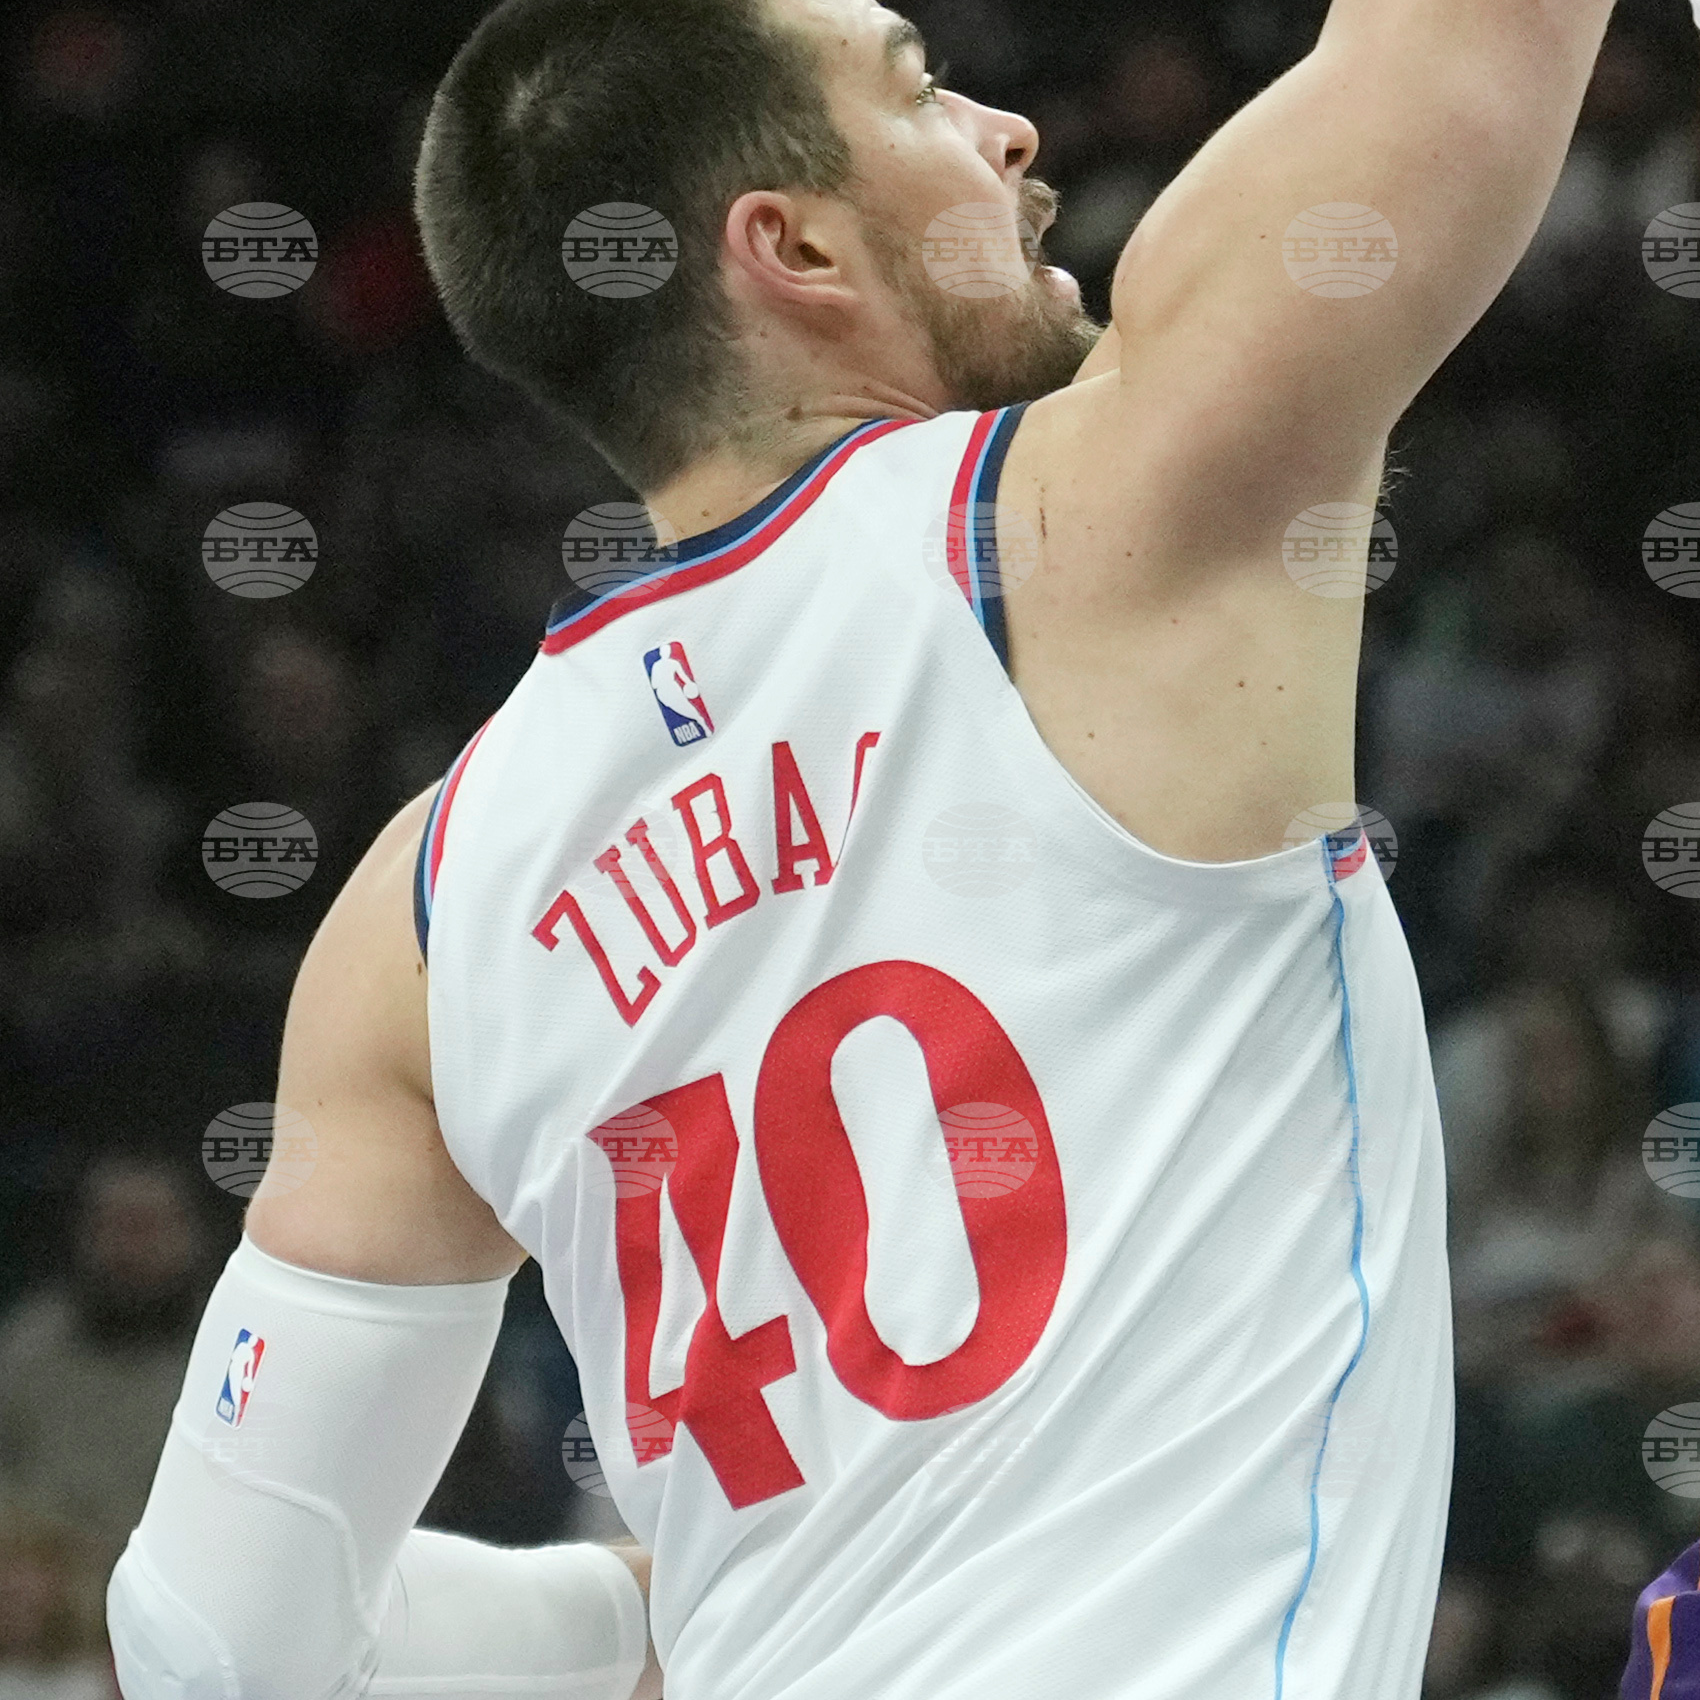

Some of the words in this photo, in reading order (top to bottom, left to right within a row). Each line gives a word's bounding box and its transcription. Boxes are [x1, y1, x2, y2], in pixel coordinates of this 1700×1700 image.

[531, 731, 882, 1028] ZUBA
[673, 721, 701, 744] NBA
[585, 959, 1068, 1512] 40
